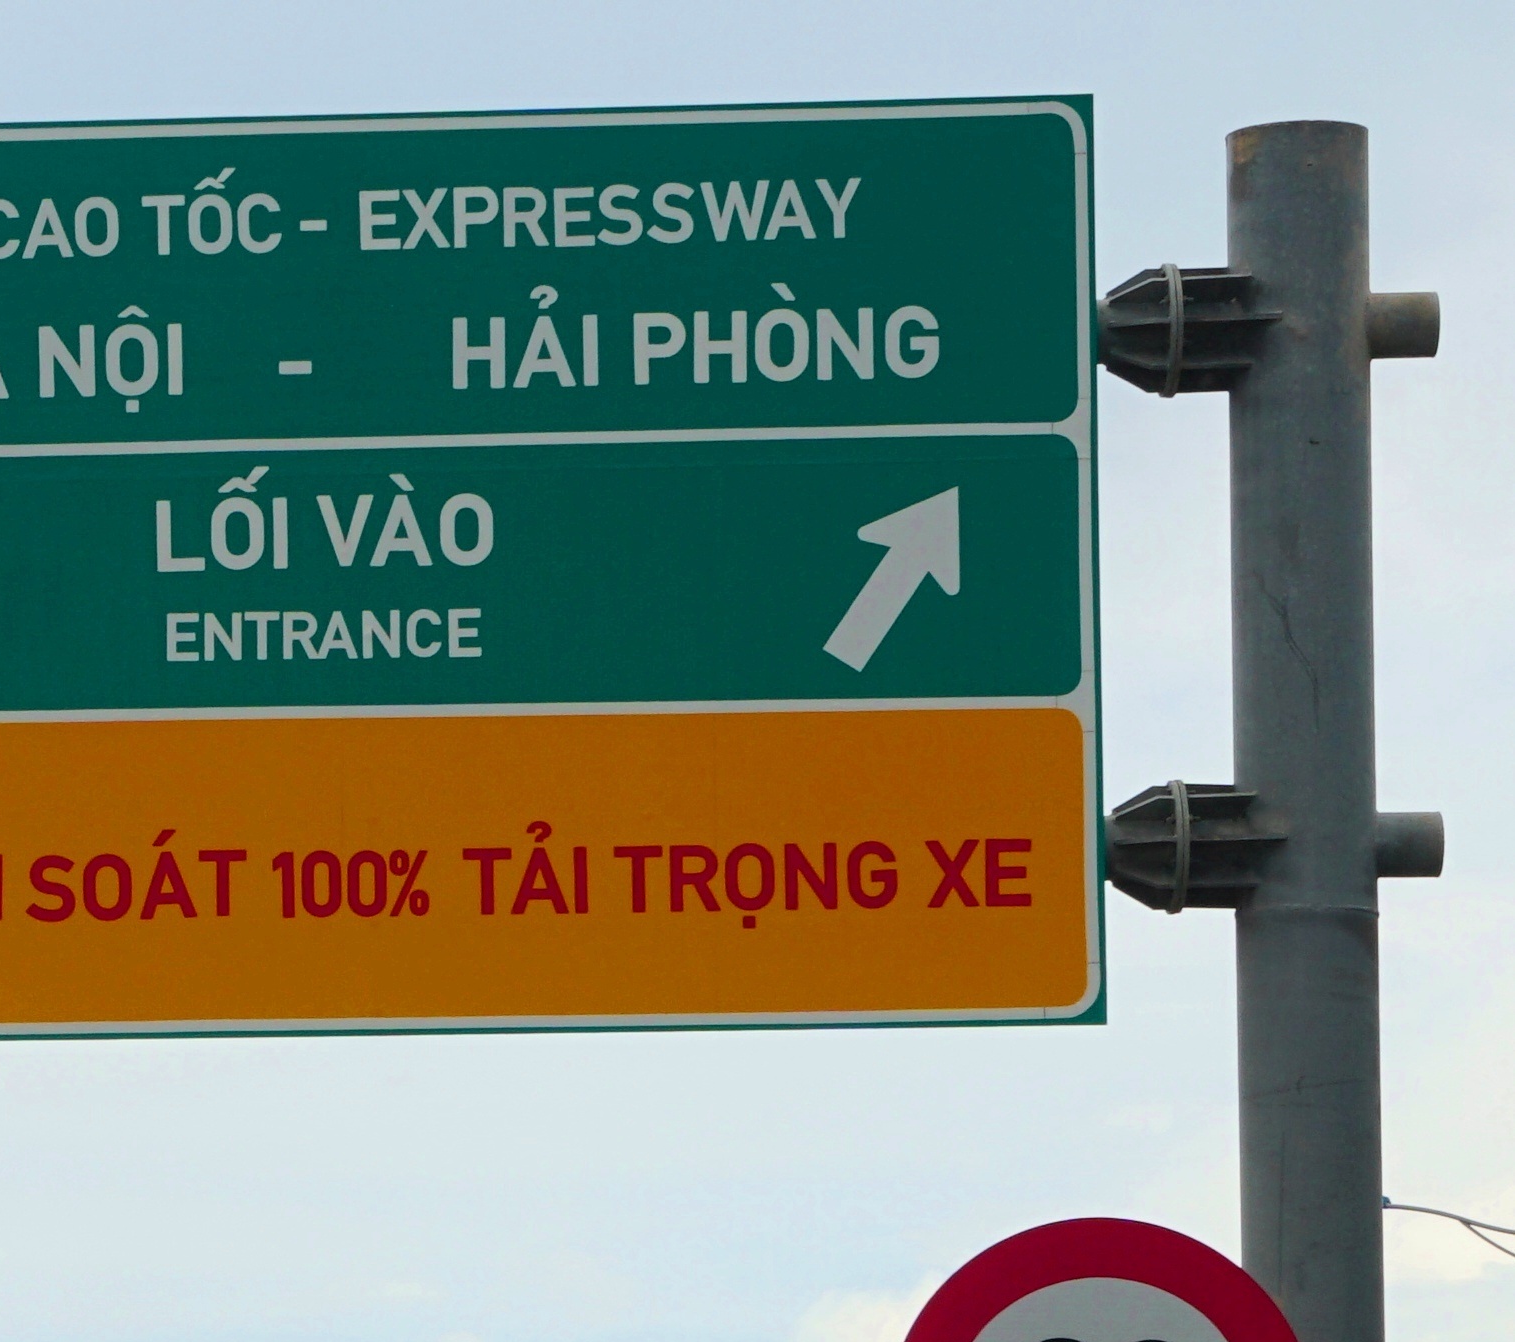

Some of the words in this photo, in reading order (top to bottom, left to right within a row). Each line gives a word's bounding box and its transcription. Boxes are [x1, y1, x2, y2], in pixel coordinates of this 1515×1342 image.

[142, 168, 281, 255] TỐC
[359, 178, 860, 250] EXPRESSWAY
[39, 306, 182, 412] NỘI
[453, 285, 598, 389] HẢI
[634, 283, 939, 384] PHÒNG
[156, 466, 288, 572] LỐI
[317, 474, 493, 566] VÀO
[167, 609, 481, 661] ENTRANCE
[26, 829, 247, 922] SOÁT
[272, 850, 430, 918] 100%
[462, 821, 589, 915] TẢI
[613, 841, 898, 929] TRỌNG
[925, 838, 1032, 908] XE
